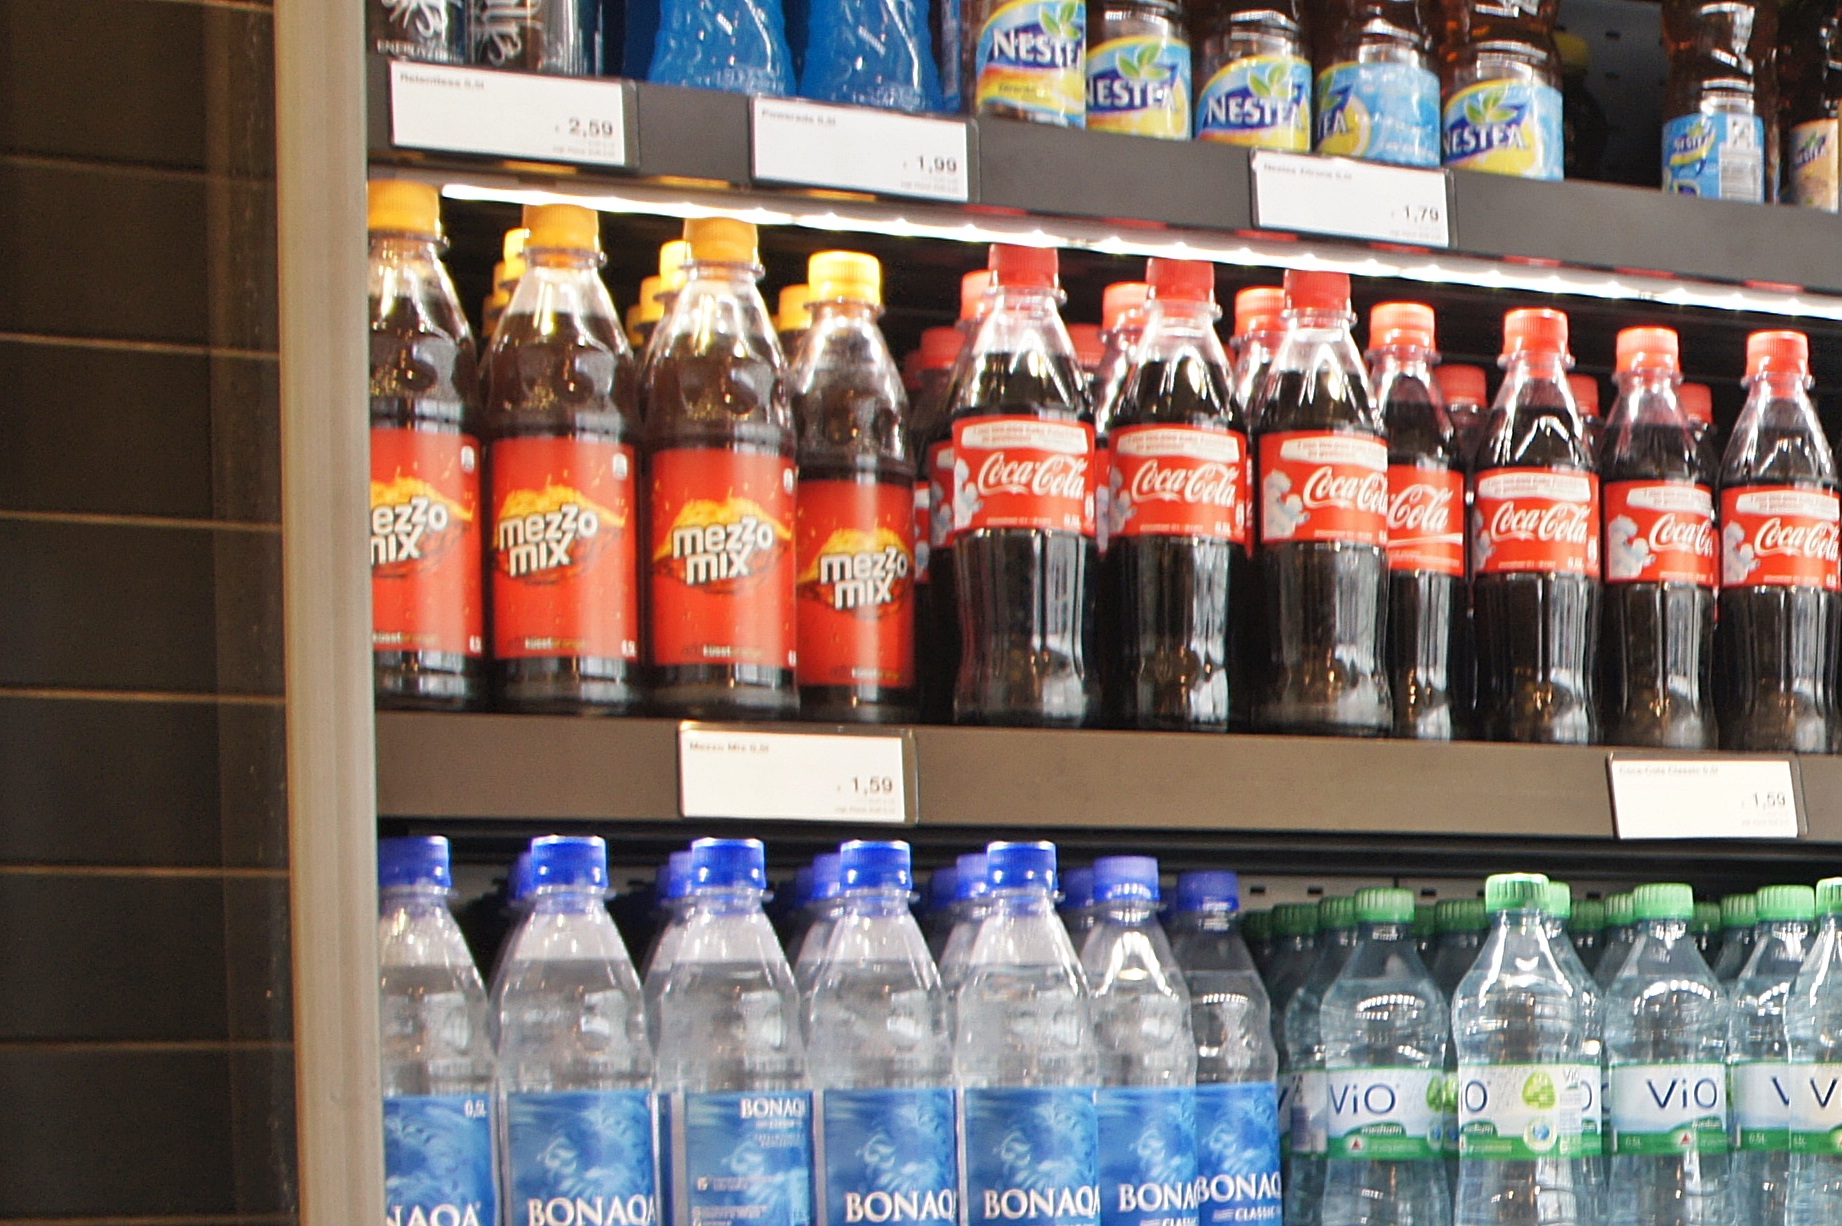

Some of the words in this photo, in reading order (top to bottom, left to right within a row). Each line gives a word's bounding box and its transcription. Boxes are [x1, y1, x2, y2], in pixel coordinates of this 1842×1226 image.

[568, 116, 613, 138] 2,59
[1207, 94, 1301, 130] NESTEA
[917, 154, 957, 174] 1,99
[977, 451, 1089, 499] Coca-Cola
[1131, 459, 1237, 507] Coca-Cola
[370, 496, 448, 534] ezzo
[499, 505, 598, 550] mezzo
[1491, 500, 1593, 544] Coca-Cola
[672, 516, 774, 559] mezzo
[508, 535, 571, 578] mix
[686, 549, 751, 586] mix
[820, 545, 908, 583] mezzo
[833, 575, 893, 610] mix
[852, 776, 893, 794] 1,59
[1329, 1082, 1397, 1116] ViO
[1646, 1077, 1719, 1110] ViO
[846, 1188, 955, 1224] BONAQ
